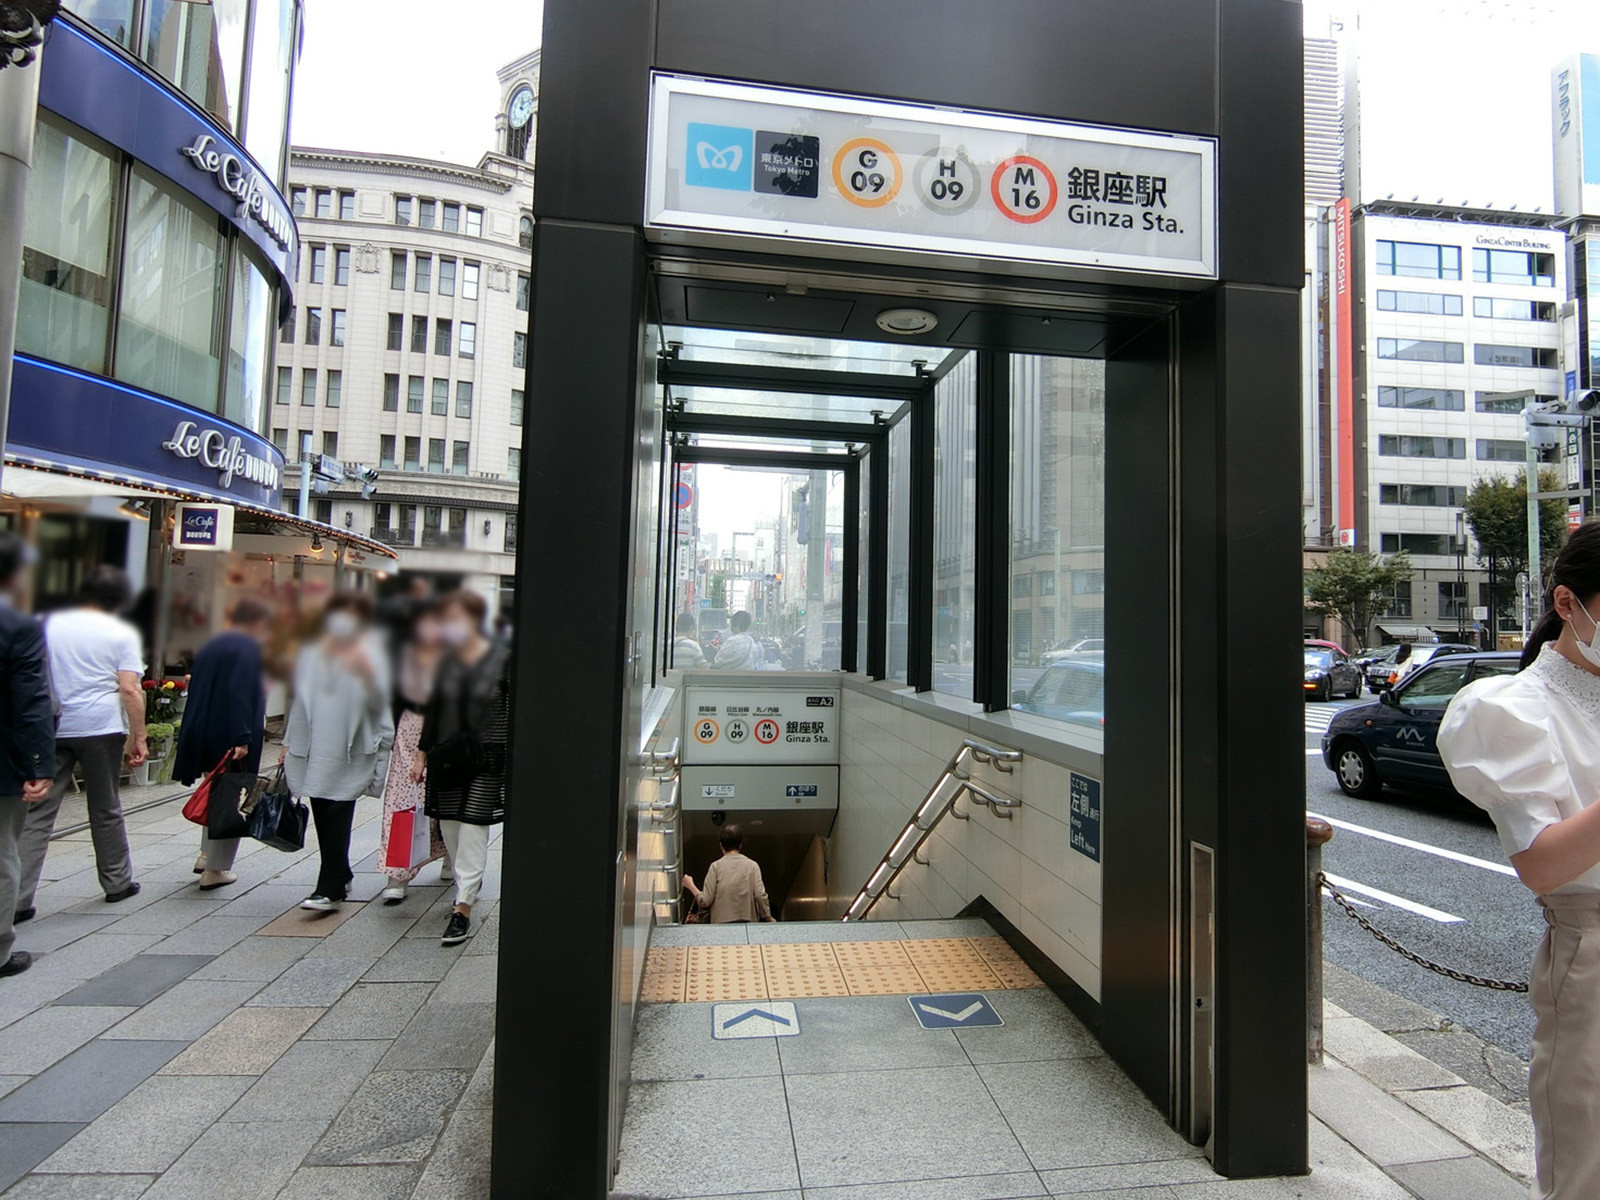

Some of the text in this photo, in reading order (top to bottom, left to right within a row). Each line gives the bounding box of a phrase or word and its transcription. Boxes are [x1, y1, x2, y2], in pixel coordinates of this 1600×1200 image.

[761, 152, 814, 168] 東京メトロ
[858, 150, 878, 169] G
[939, 159, 956, 178] H
[182, 135, 220, 172] Le
[216, 153, 262, 219] Café
[764, 164, 810, 176] Tokyo Metro
[1014, 167, 1036, 187] M
[851, 171, 885, 193] 09
[931, 179, 964, 201] 09
[1067, 166, 1168, 209] 銀座駅
[1012, 188, 1041, 210] 16
[1067, 204, 1184, 234] Ginza Sta.
[1337, 206, 1346, 295] MITSUKOSHI
[162, 421, 201, 458] Le
[198, 429, 246, 488] Café
[185, 516, 214, 529] Le Café
[820, 697, 833, 706] A2
[700, 731, 713, 739] 09
[731, 731, 743, 739] 09
[761, 731, 773, 739] 16
[786, 721, 824, 734] 銀座駅
[785, 735, 831, 743] Ginza Sta.
[1071, 829, 1085, 849] Left
